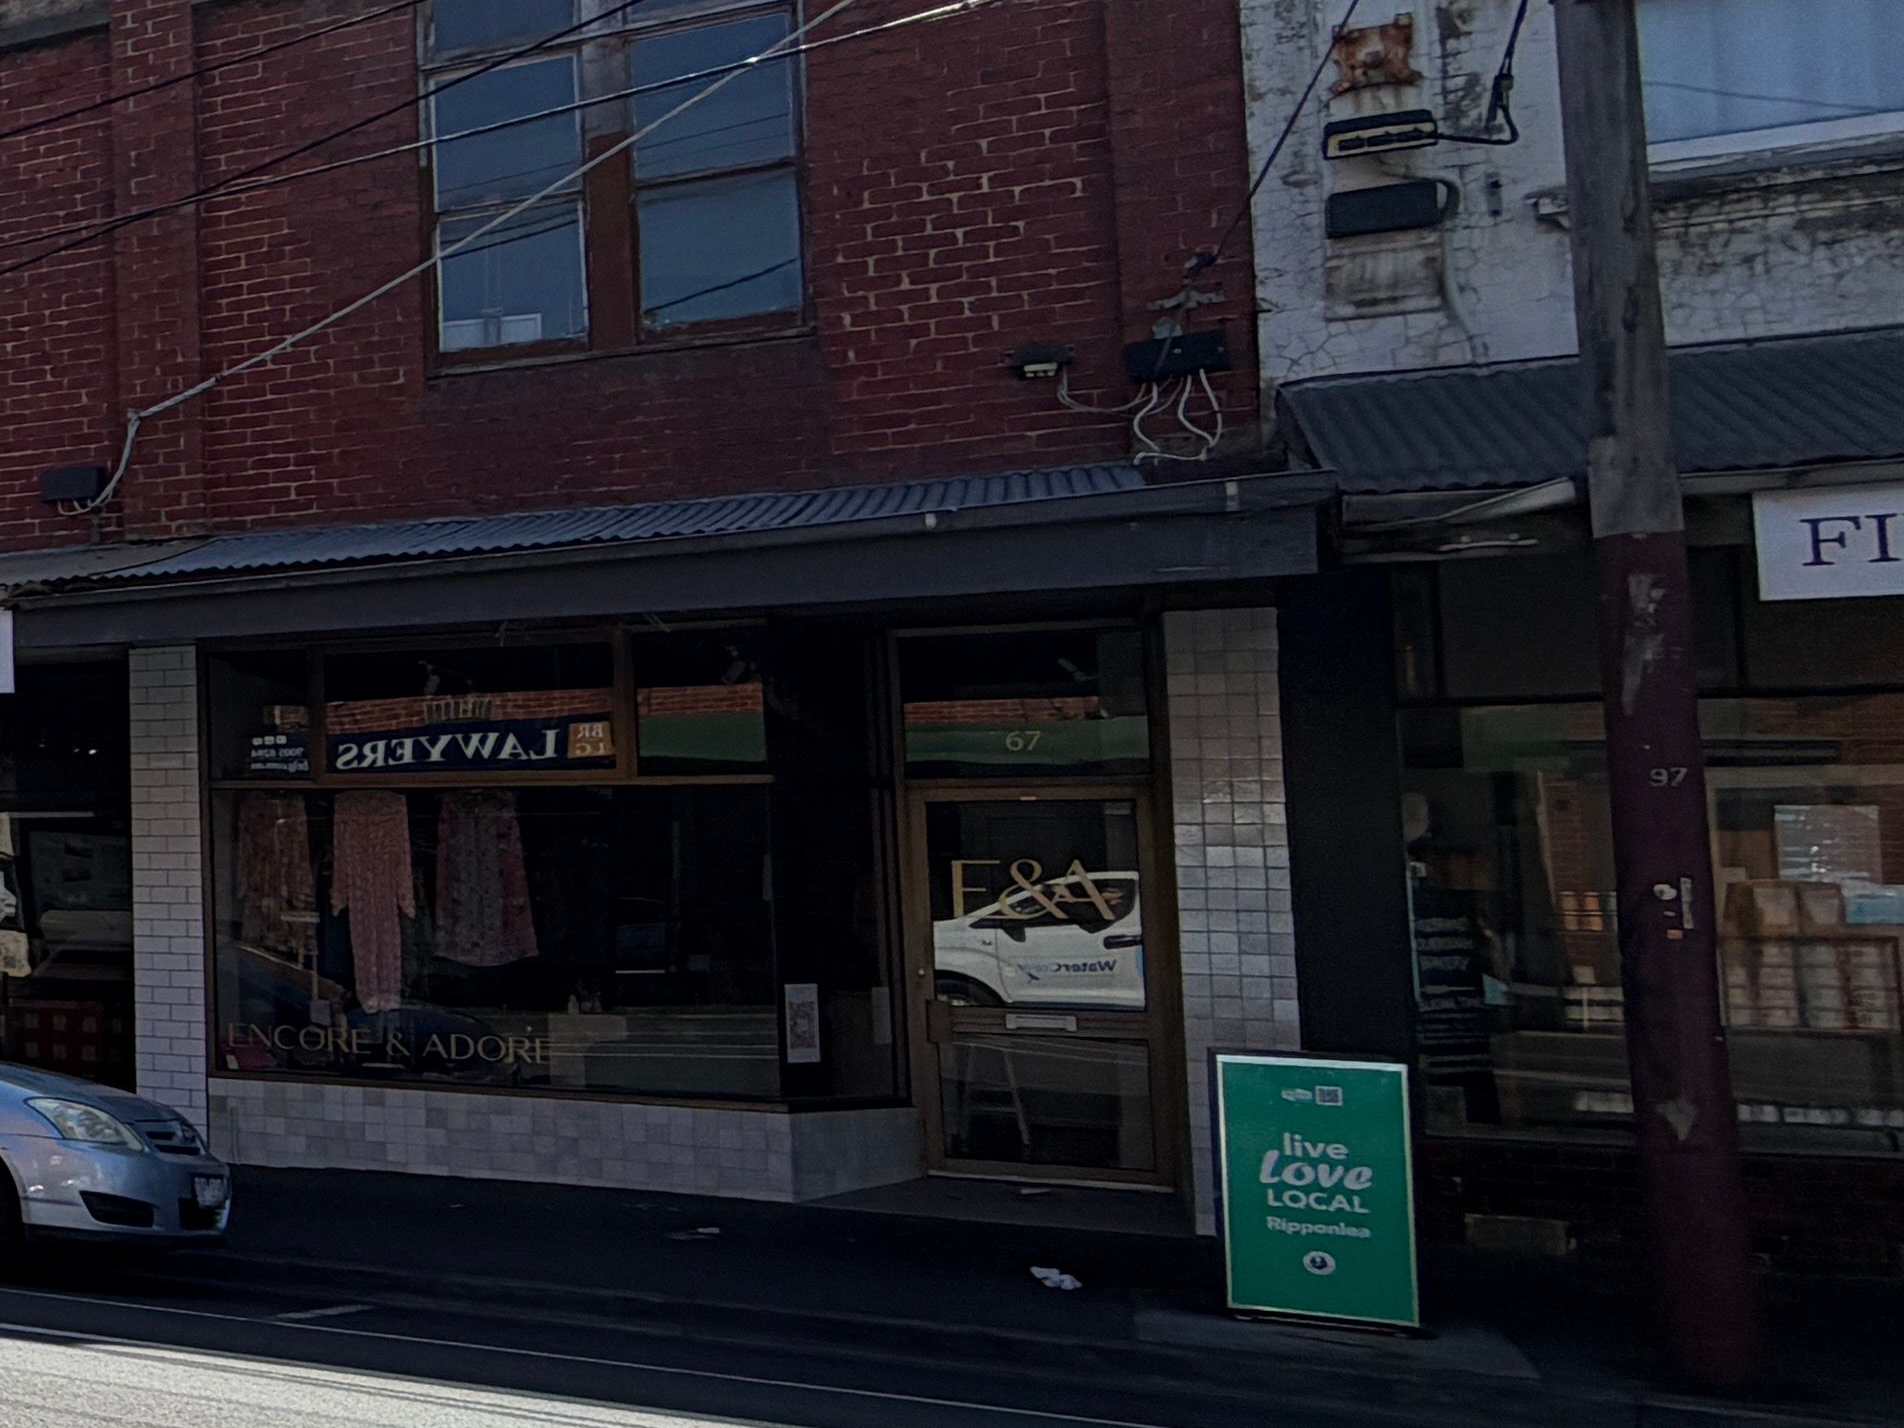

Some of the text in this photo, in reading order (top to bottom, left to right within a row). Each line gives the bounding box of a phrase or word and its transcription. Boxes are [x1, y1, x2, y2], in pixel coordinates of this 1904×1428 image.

[1006, 730, 1041, 751] 67
[1649, 766, 1688, 787] 97
[228, 1022, 550, 1065] ENCORE & ADORE
[1283, 1132, 1349, 1160] live
[1266, 1188, 1371, 1214] LOCAL
